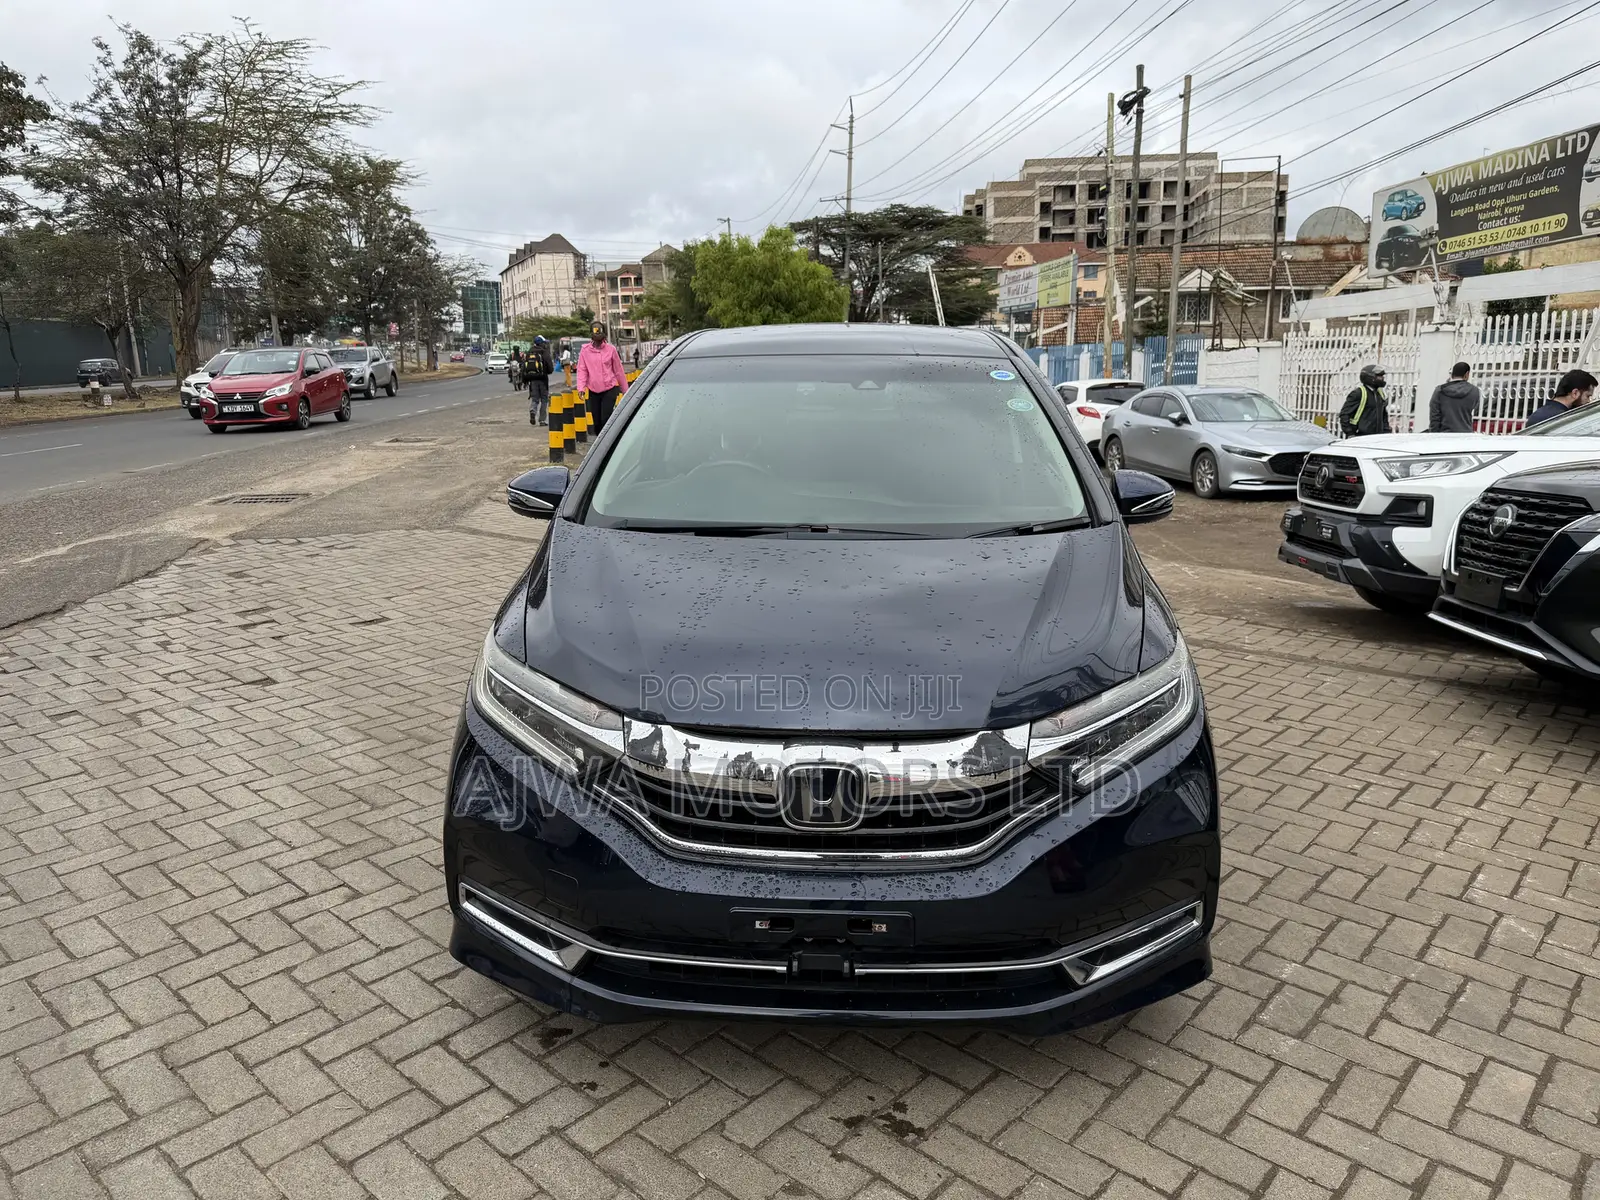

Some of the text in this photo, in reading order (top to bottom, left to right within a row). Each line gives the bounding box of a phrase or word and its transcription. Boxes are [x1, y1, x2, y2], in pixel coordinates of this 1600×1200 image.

[1435, 131, 1590, 195] AJWA MADINA LTD
[1450, 166, 1566, 204] Dealers in new and used cars
[1451, 205, 1474, 218] Langata
[1475, 202, 1490, 211] Road
[1529, 185, 1560, 198] Gardens,
[1478, 214, 1521, 231] Contact us:
[1505, 204, 1525, 215] Kenya
[1449, 239, 1466, 251] 0746
[1467, 236, 1476, 248] 51
[1479, 234, 1488, 245] 53
[1490, 231, 1499, 243] 53
[1507, 225, 1527, 239] 0748
[1530, 223, 1540, 234] 10
[1542, 220, 1551, 231] 11
[1555, 217, 1566, 229] 90
